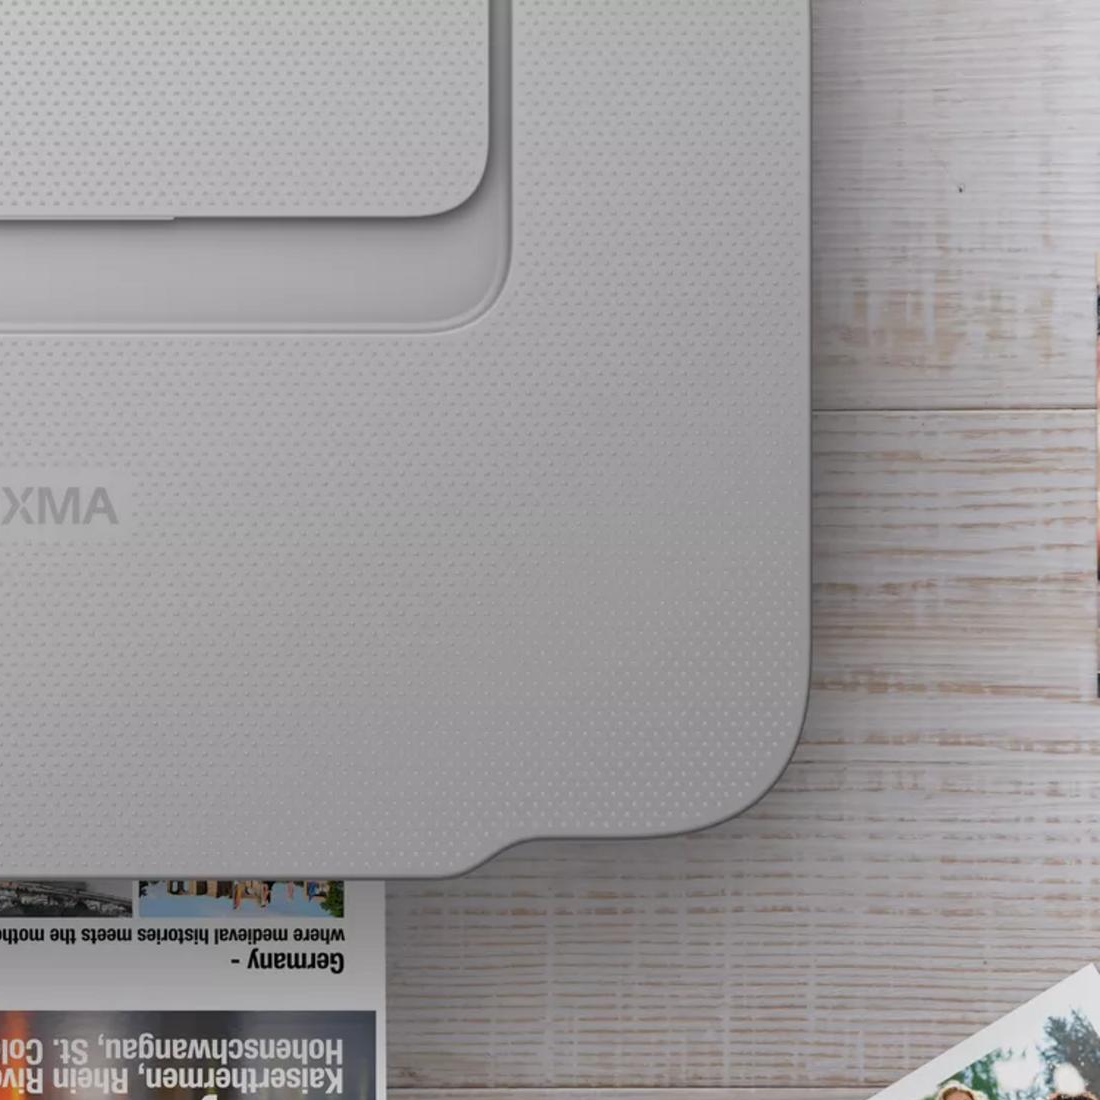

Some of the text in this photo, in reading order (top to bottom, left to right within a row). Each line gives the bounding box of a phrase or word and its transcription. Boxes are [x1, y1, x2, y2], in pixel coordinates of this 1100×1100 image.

[50, 928, 76, 945] the
[81, 928, 133, 945] meets
[137, 928, 209, 945] histories
[215, 928, 288, 945] medieval
[293, 928, 345, 945] where
[247, 948, 344, 974] Germany
[53, 1038, 88, 1065] St.
[98, 1033, 343, 1065] Hohenschwangau,
[53, 1067, 128, 1094] Rhein
[138, 1063, 343, 1094] Kaiserthermen,
